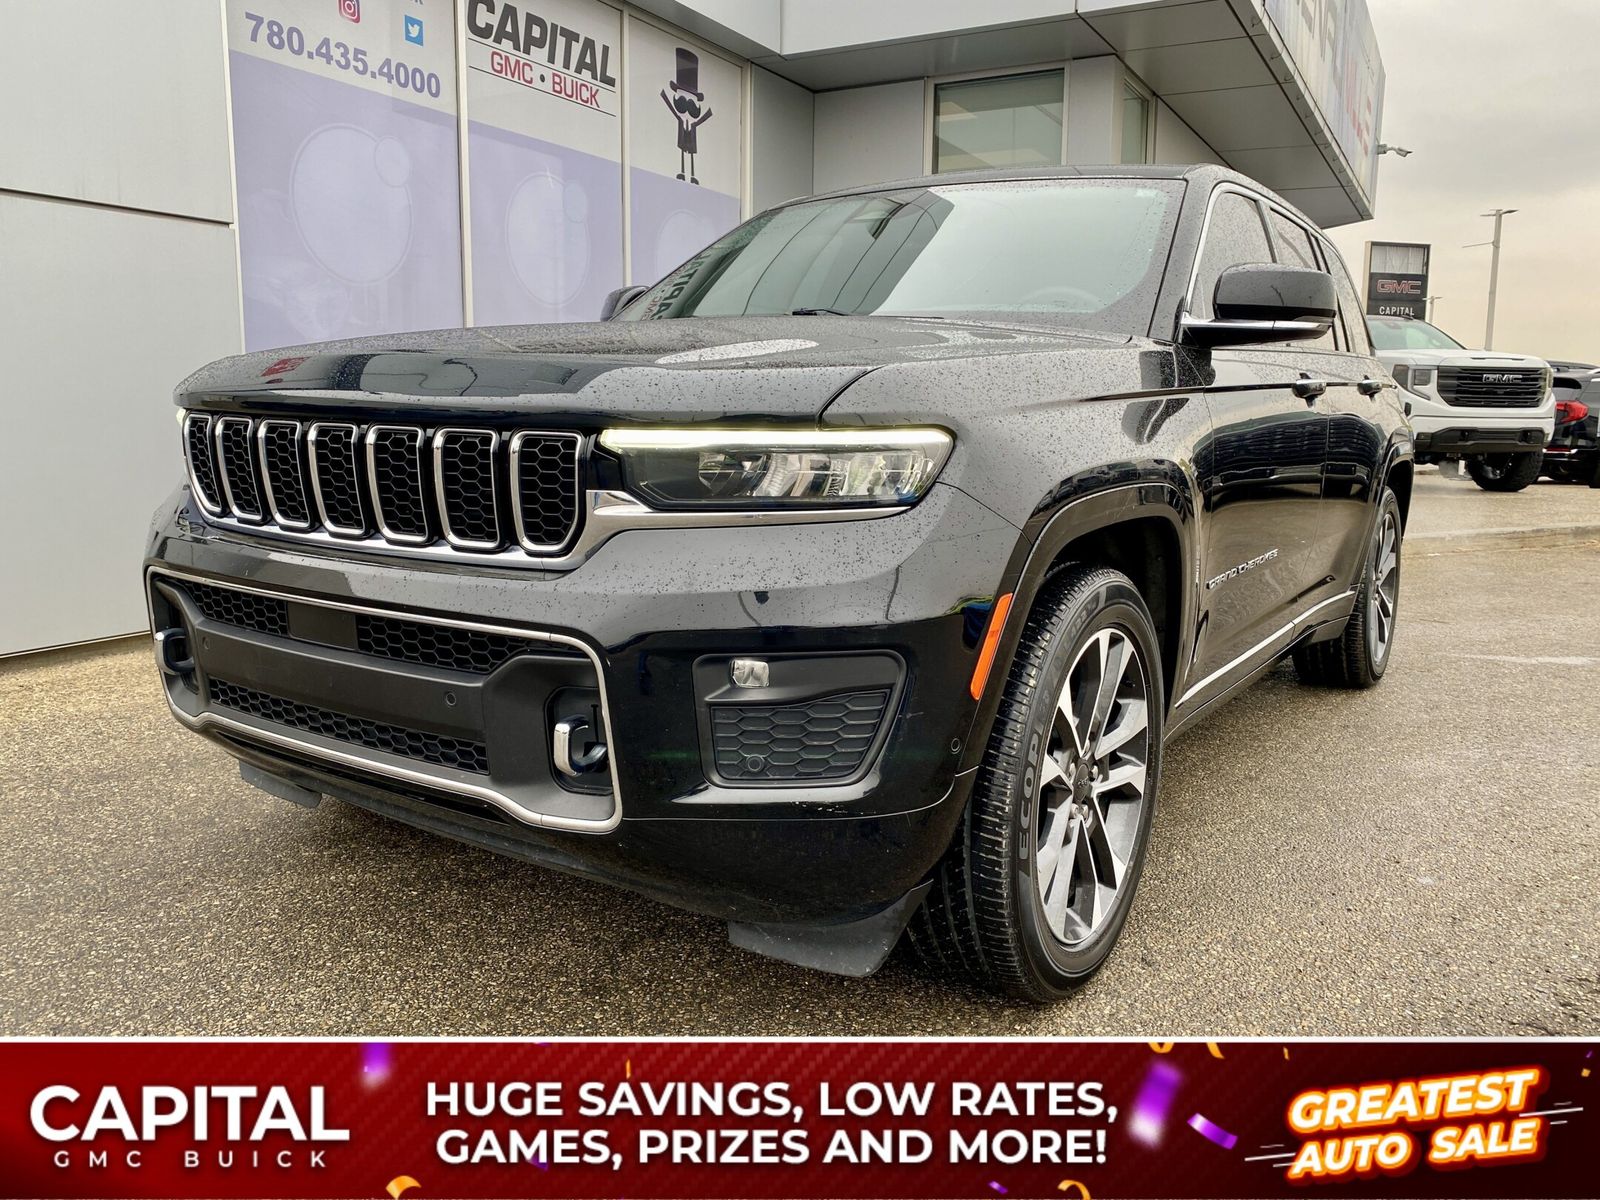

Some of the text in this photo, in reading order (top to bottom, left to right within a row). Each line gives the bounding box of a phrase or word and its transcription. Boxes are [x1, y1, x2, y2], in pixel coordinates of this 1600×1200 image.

[244, 11, 441, 98] 780.435.4000
[467, 0, 616, 87] CAPITAL
[491, 51, 600, 108] GMC BUICK
[1376, 279, 1422, 295] GMC
[1379, 306, 1415, 317] CAPITAL
[1482, 373, 1523, 384] GMC
[1207, 548, 1279, 590] GRAND CHEROKEE
